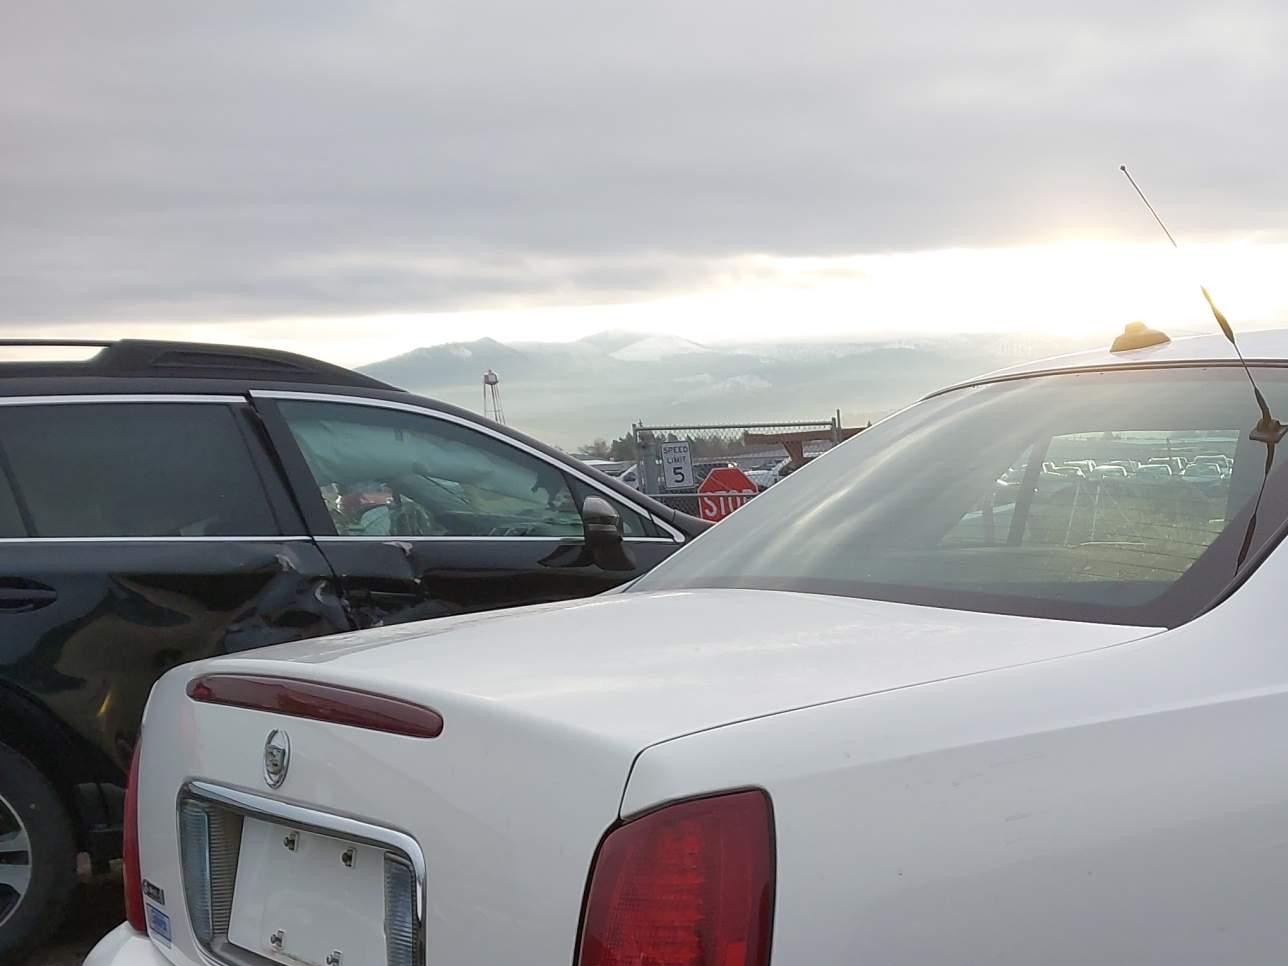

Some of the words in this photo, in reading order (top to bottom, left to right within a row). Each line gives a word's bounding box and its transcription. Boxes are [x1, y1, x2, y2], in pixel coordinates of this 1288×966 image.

[663, 446, 688, 454] SPEED
[666, 456, 687, 464] LIMIT
[672, 466, 686, 483] 5
